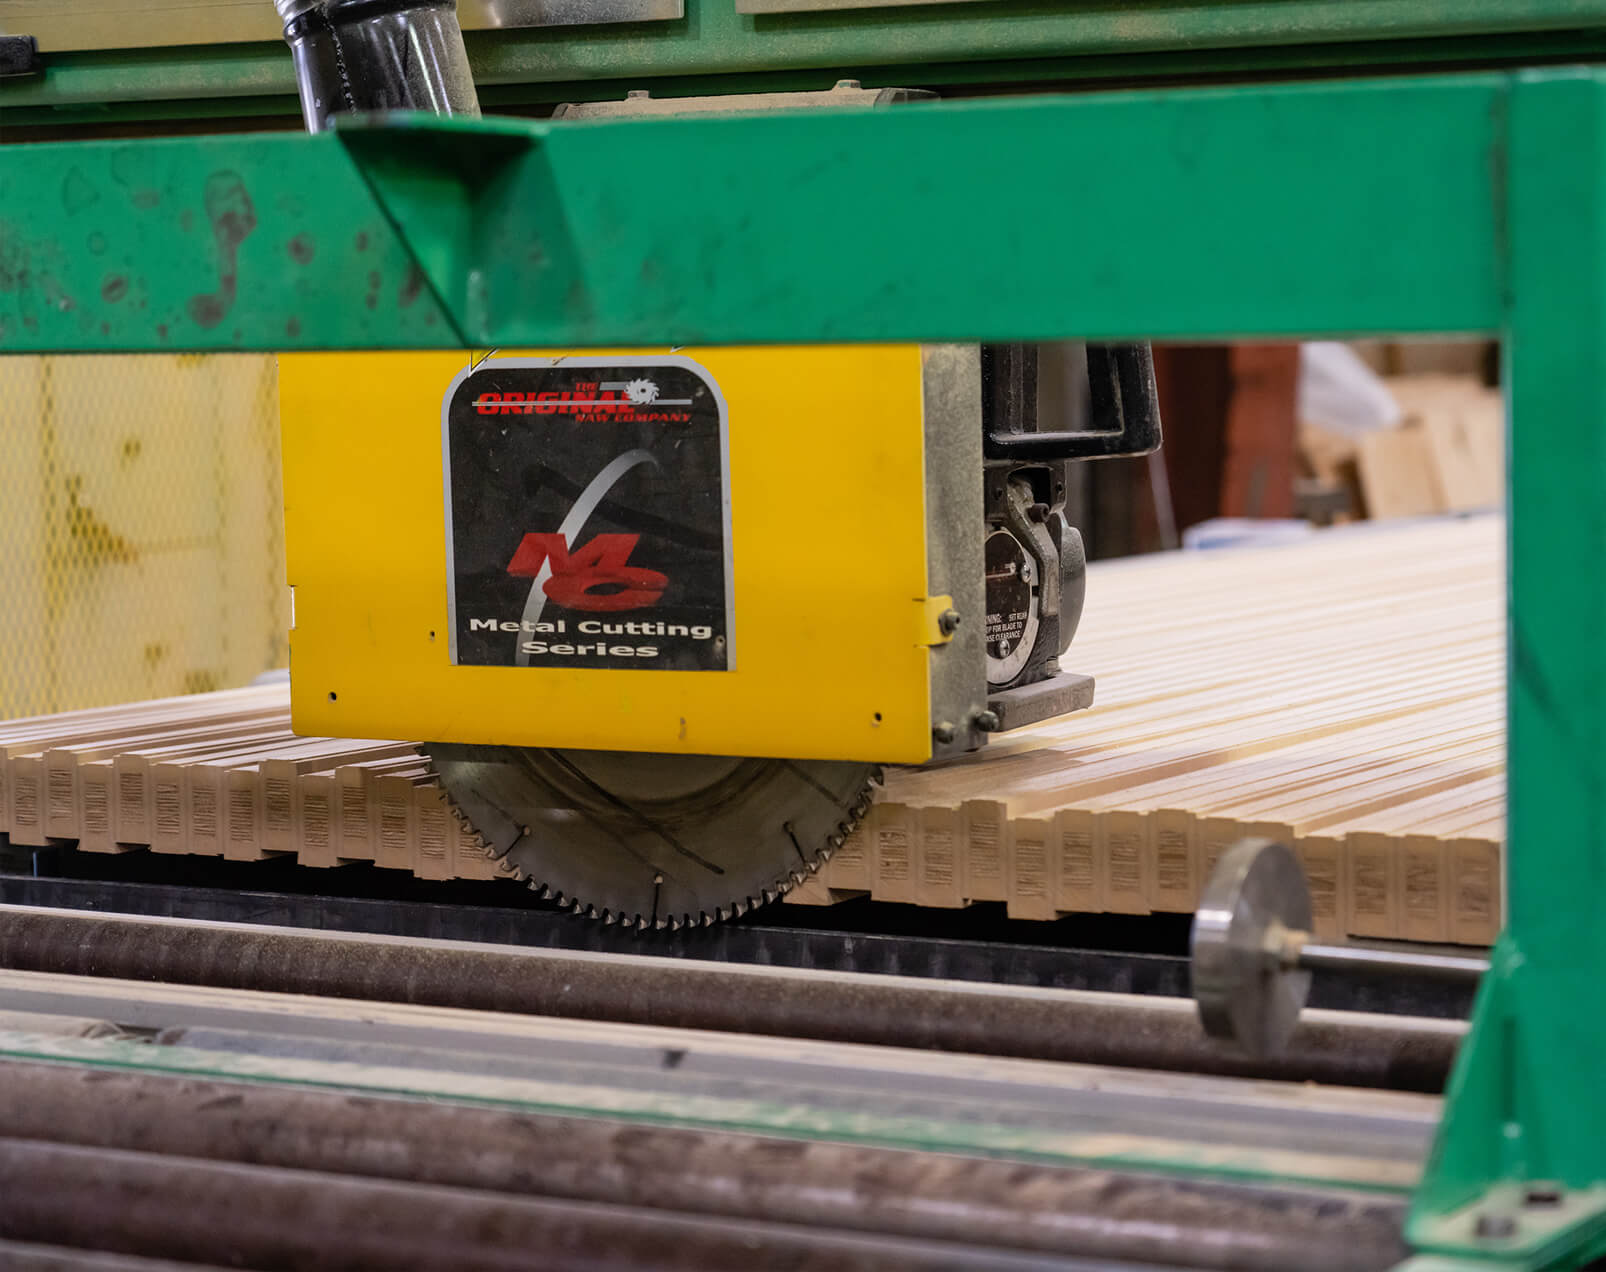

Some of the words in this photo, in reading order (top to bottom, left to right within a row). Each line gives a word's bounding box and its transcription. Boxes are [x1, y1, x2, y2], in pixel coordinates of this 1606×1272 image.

[575, 381, 599, 392] THE
[476, 391, 635, 416] ORIGINAL
[614, 412, 692, 424] COMPANY
[469, 618, 566, 634] Metal
[577, 620, 713, 640] Cutting
[521, 640, 660, 658] Series
